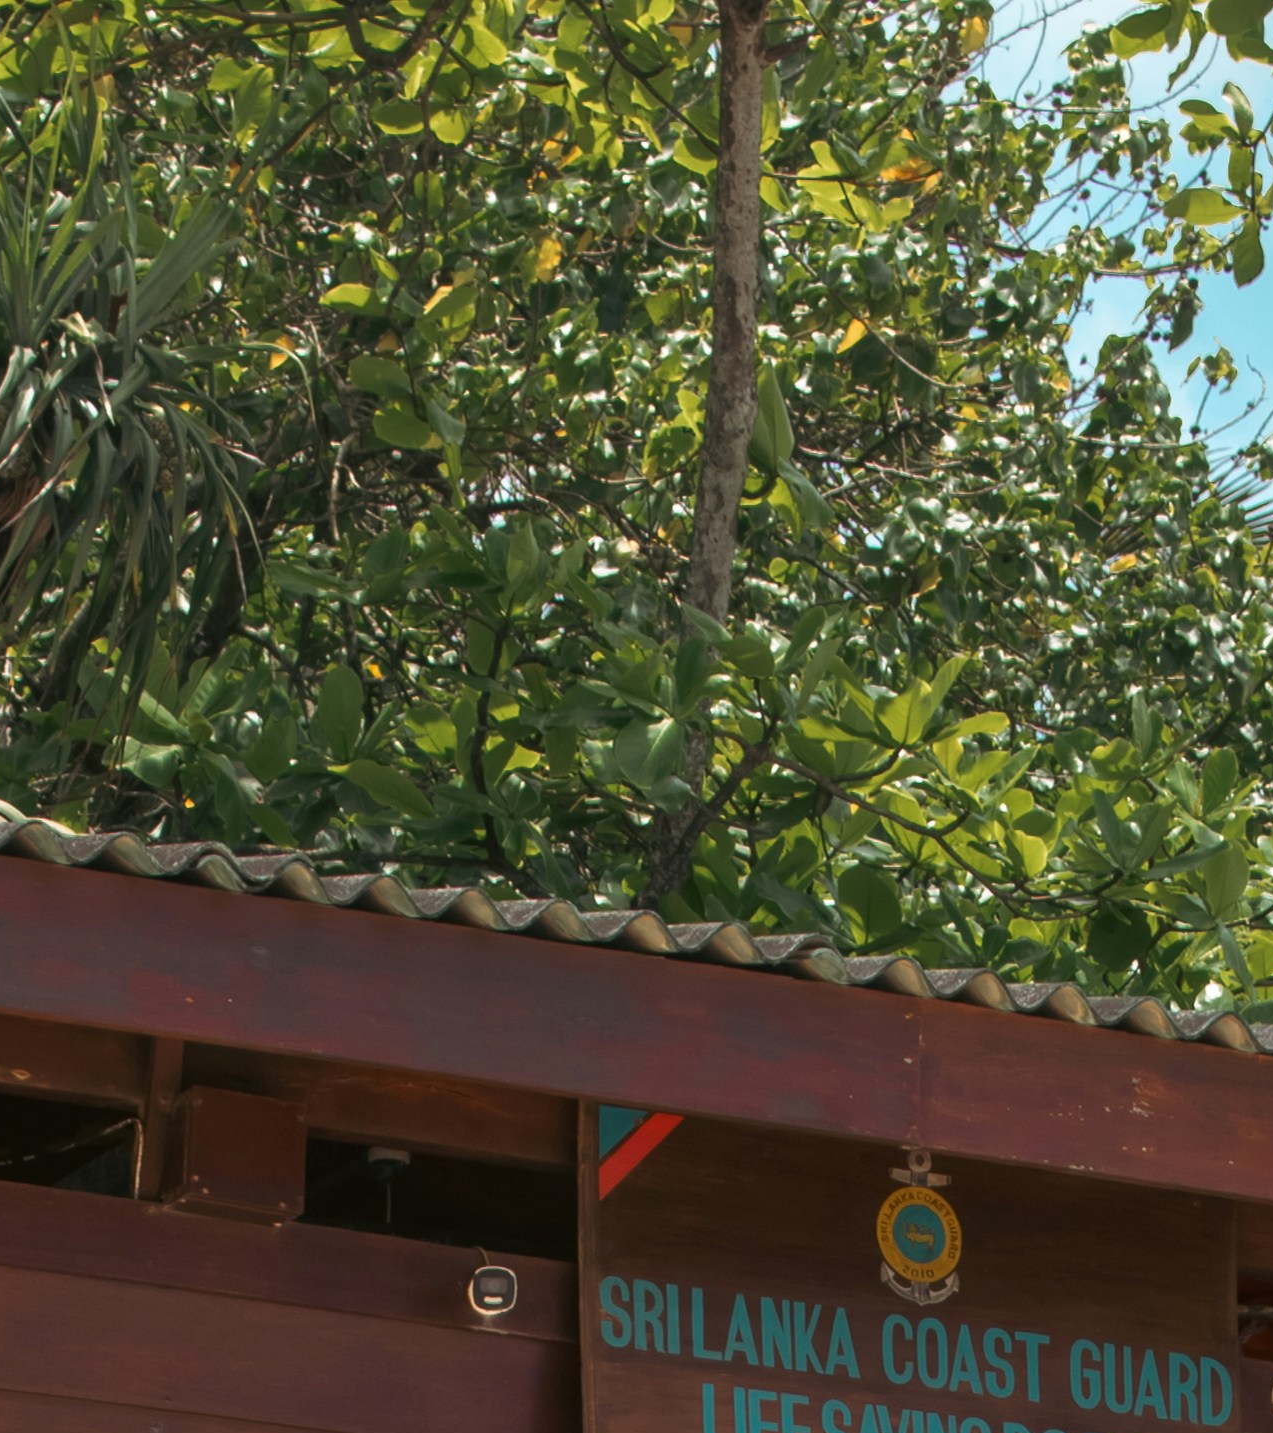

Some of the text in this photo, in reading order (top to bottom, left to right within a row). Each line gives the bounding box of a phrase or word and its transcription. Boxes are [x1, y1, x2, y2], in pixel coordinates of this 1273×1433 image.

[902, 1264, 935, 1279] 2010
[599, 1275, 1234, 1427] SRI LANKA COAST GUARD
